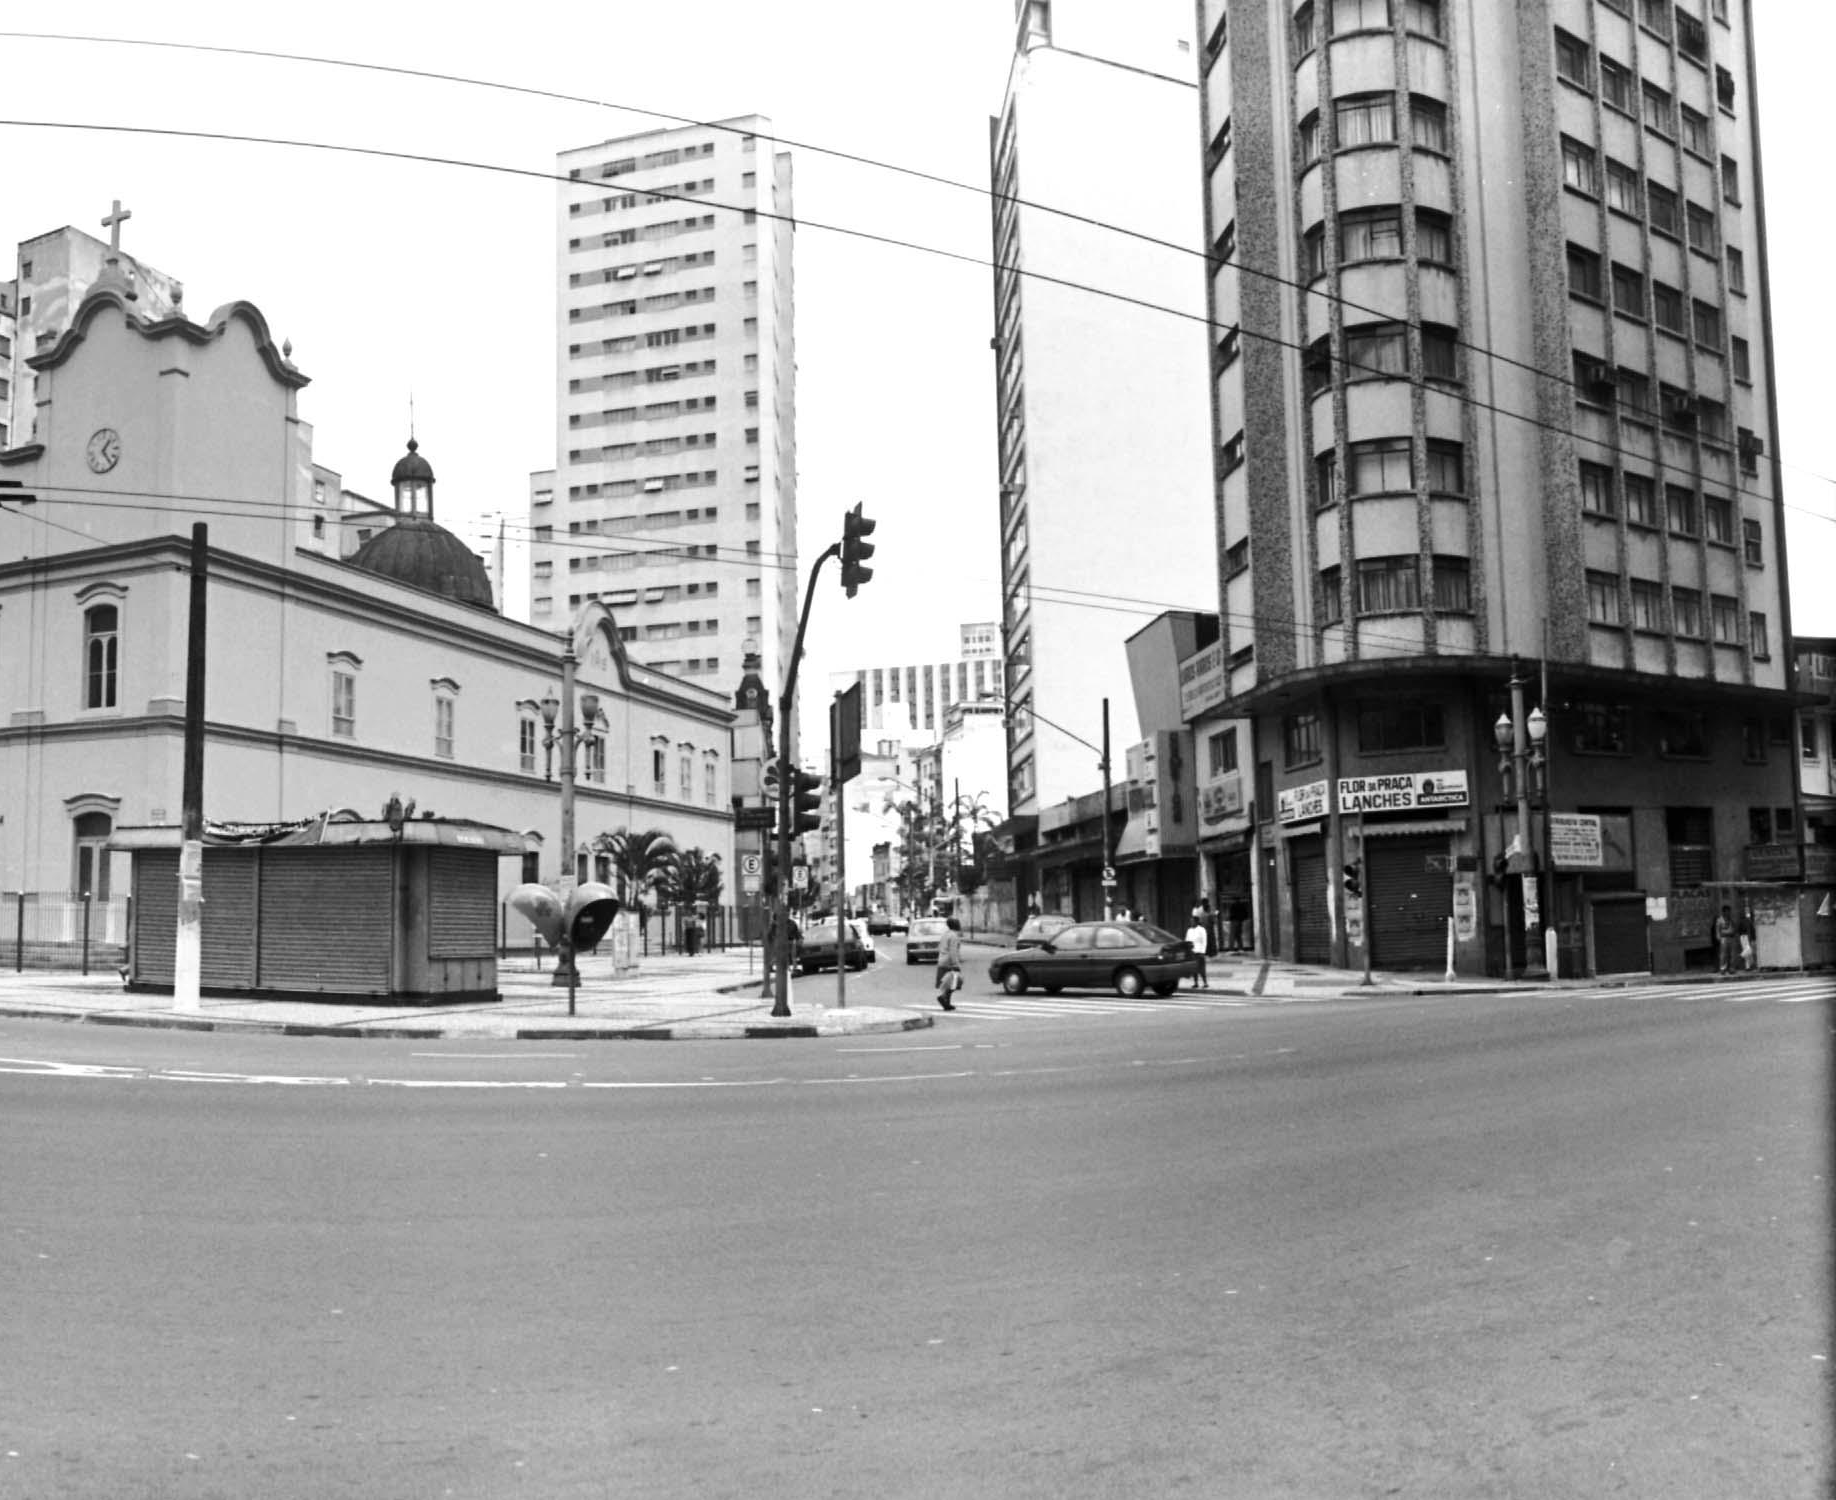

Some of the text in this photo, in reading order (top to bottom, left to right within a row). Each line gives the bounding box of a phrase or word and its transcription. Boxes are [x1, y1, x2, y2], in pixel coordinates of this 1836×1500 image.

[1340, 779, 1366, 794] FLOR
[1342, 792, 1413, 810] LANCHES
[748, 859, 755, 870] E
